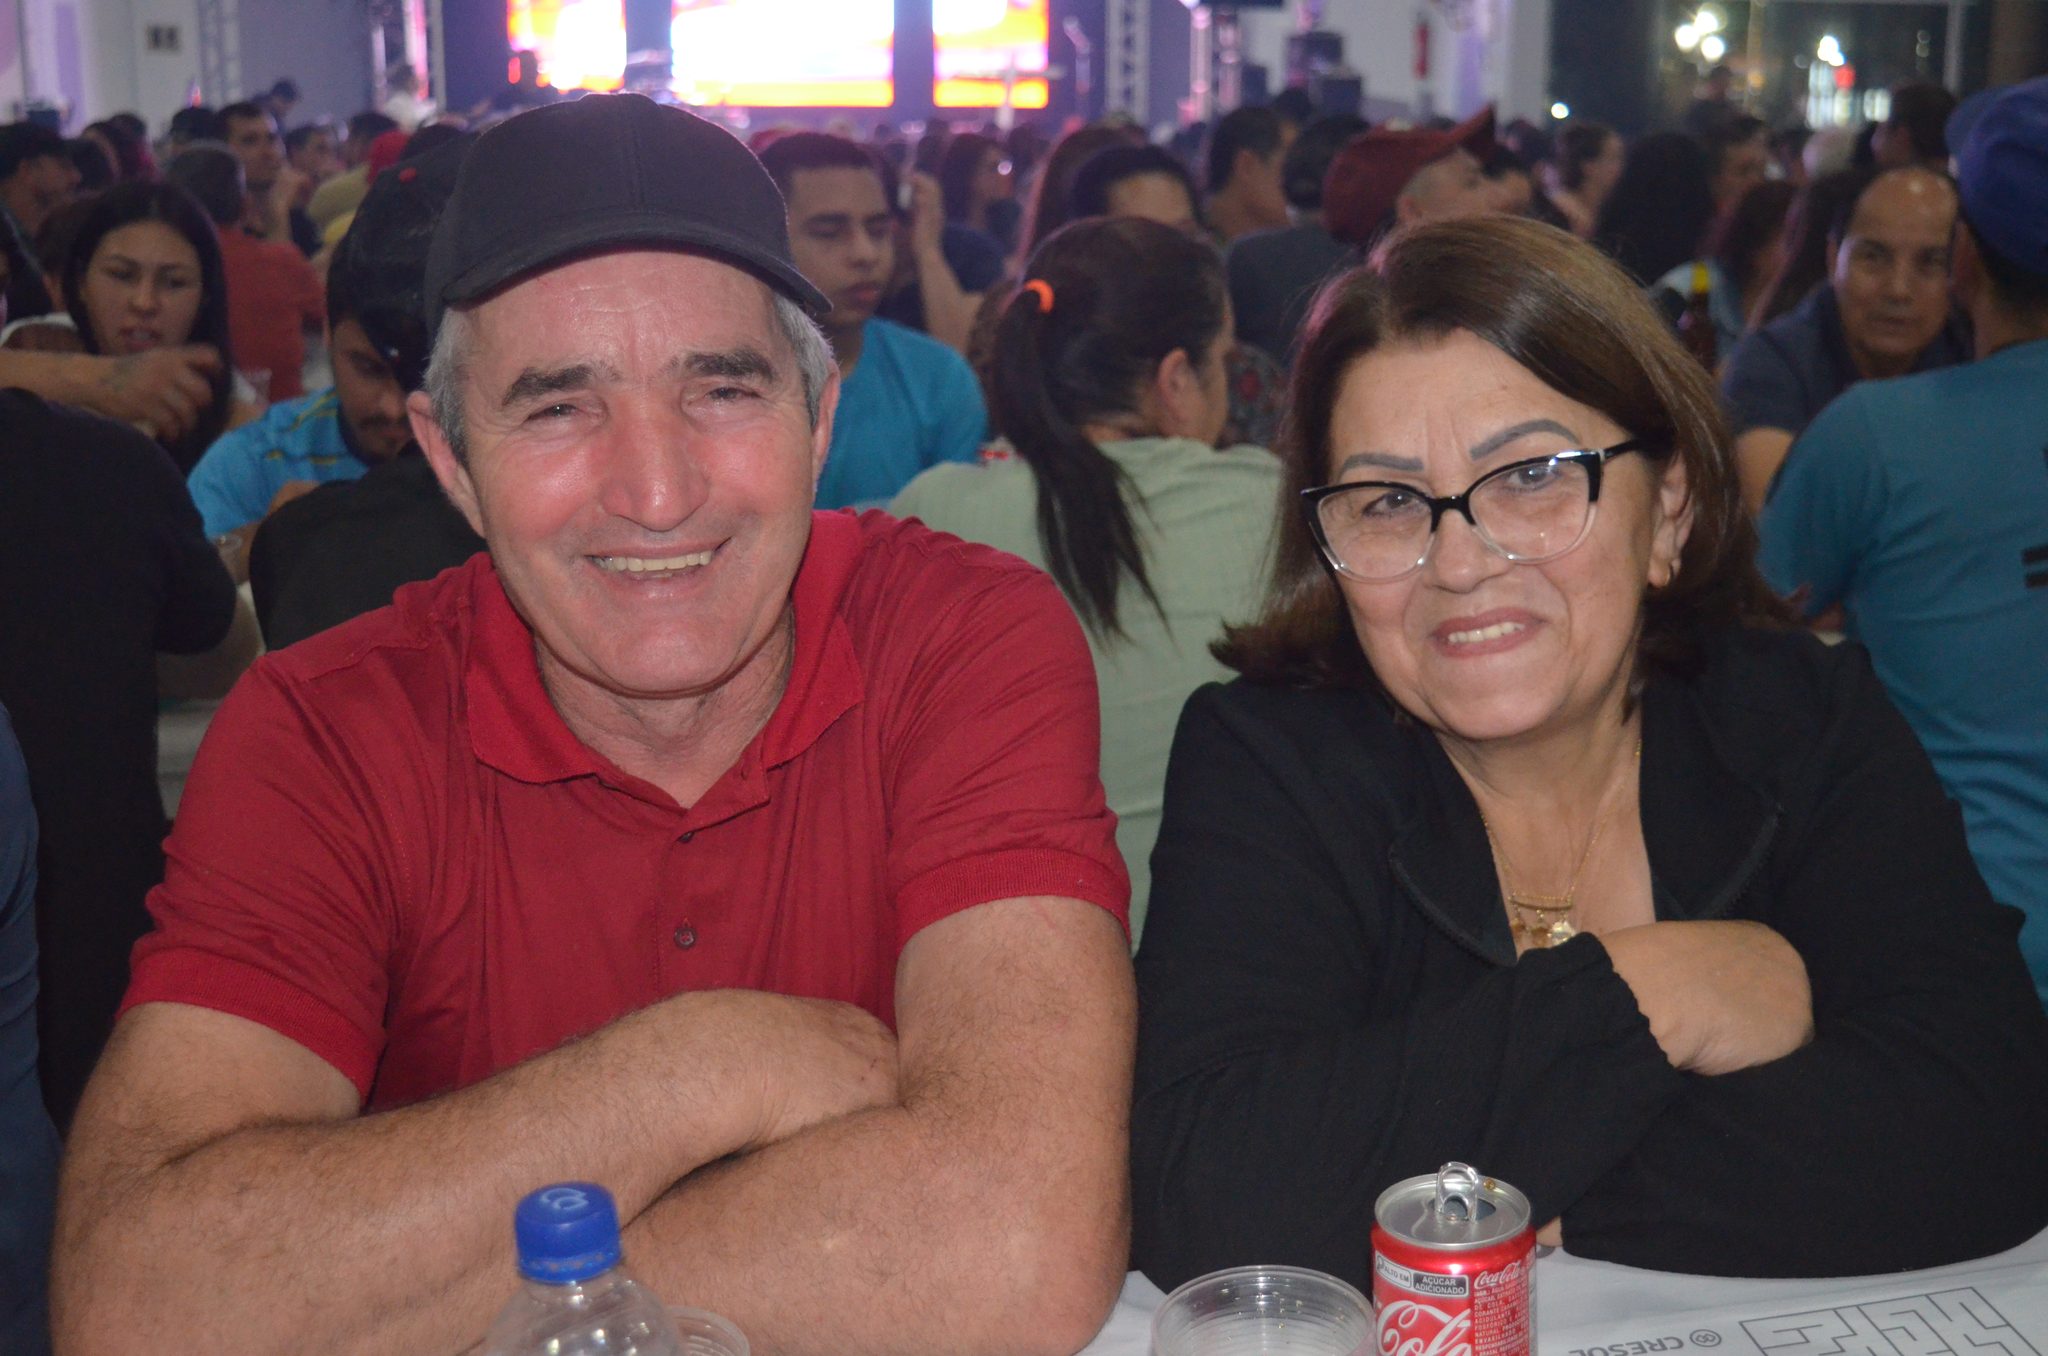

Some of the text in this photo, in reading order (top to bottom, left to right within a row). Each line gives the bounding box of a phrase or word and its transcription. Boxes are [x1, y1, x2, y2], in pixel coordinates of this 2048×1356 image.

[1384, 1265, 1409, 1283] ALTO EM
[1415, 1283, 1465, 1294] ADICIONADO
